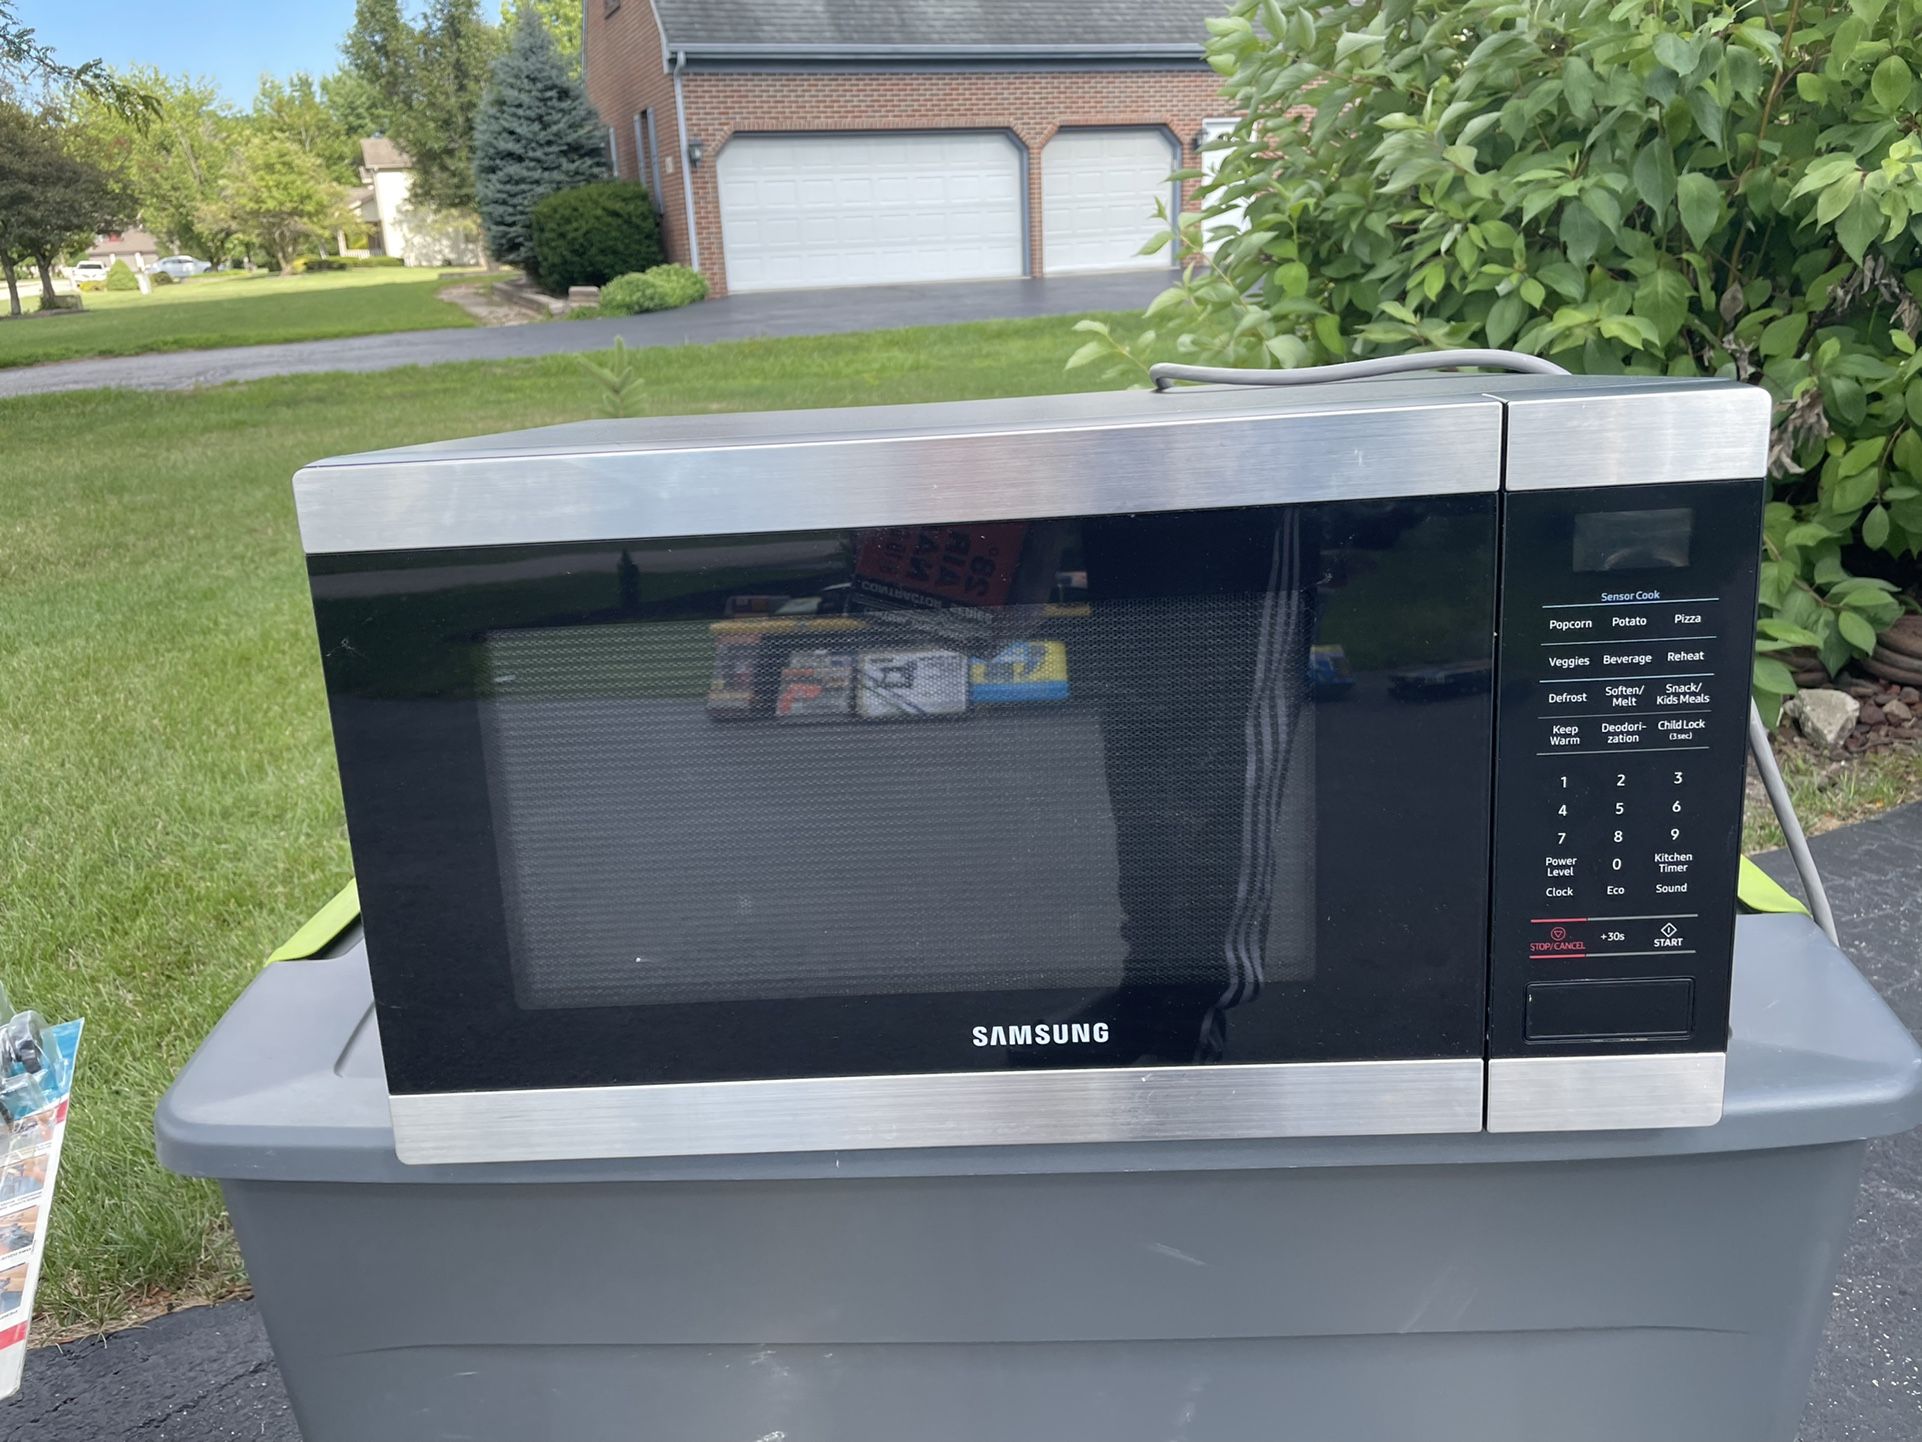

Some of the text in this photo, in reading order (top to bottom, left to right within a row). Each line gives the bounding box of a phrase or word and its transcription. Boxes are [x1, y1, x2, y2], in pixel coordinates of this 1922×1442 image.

[1601, 590, 1660, 601] Sensor Cook
[1612, 616, 1646, 626] Potato
[1675, 614, 1701, 623] Pizza
[1550, 619, 1592, 630] Popcorn
[1603, 653, 1652, 665] Beverage
[1667, 652, 1704, 661] Reheat
[1549, 656, 1590, 668] Veggies
[1605, 686, 1644, 696] Soften/
[1666, 683, 1702, 693] Snack/
[1549, 693, 1587, 703] Defrost
[1612, 697, 1636, 706] Melt
[1657, 694, 1709, 705] Kids Meals
[1601, 723, 1647, 733] Deodori-
[1658, 719, 1705, 729] Child Lock
[1553, 725, 1578, 736] Keep
[1550, 735, 1580, 745] Warm
[1608, 734, 1639, 743] zation
[1560, 776, 1567, 788] 1
[1617, 775, 1625, 786] 2
[1674, 772, 1682, 784] 3
[1558, 805, 1568, 816] 4
[1616, 803, 1624, 814] 5
[1672, 801, 1681, 812] 6
[1558, 833, 1566, 844] 7
[1614, 831, 1623, 842] 8
[1671, 828, 1680, 840] 9
[1546, 857, 1576, 867] Power
[1654, 853, 1692, 862] Kitchen
[1612, 859, 1622, 870] 0
[1659, 864, 1688, 872] Timer
[1547, 867, 1574, 876] Level
[1546, 887, 1573, 897] Clock
[1607, 886, 1624, 895] Eco
[1656, 883, 1687, 893] Sound
[1600, 932, 1624, 942] +30s
[1530, 941, 1586, 951] STOP/CANCEL
[1654, 938, 1683, 947] START
[973, 1023, 1108, 1046] SAMSUNG
